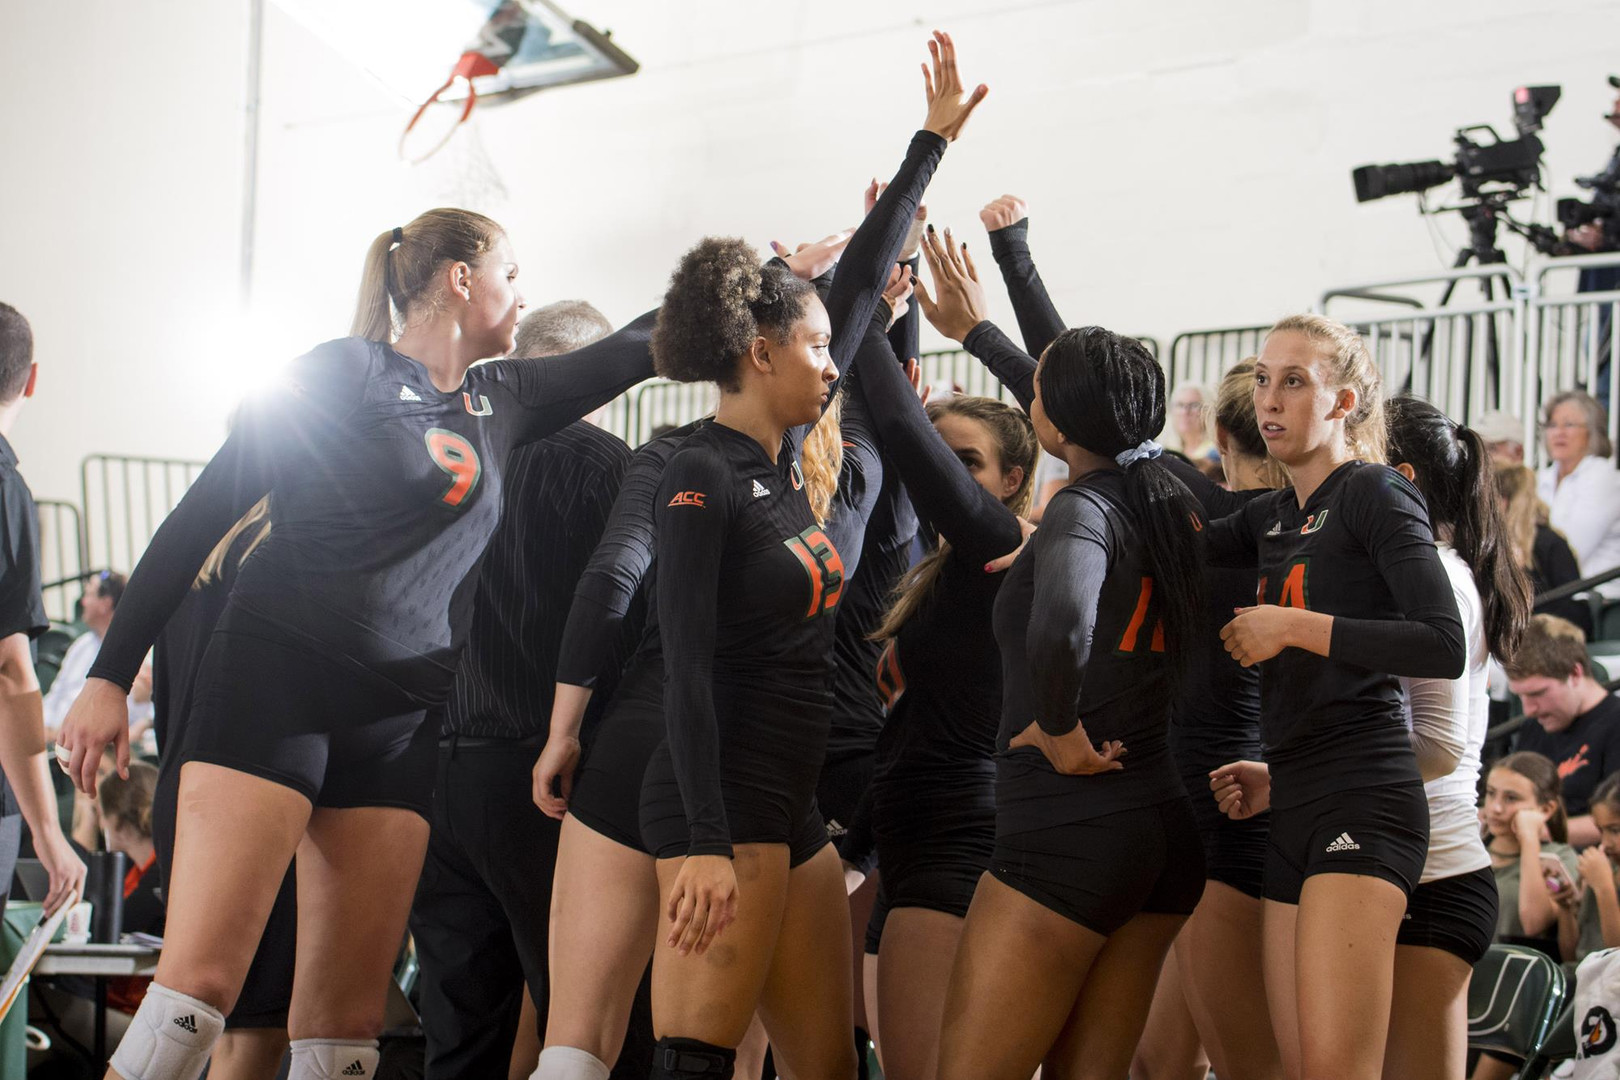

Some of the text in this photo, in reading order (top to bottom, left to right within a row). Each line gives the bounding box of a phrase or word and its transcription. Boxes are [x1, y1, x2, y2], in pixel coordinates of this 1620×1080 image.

[425, 427, 481, 507] 9
[670, 491, 707, 505] ACC
[783, 525, 845, 619] 13
[1325, 843, 1361, 853] adidas
[173, 1018, 198, 1034] adidas
